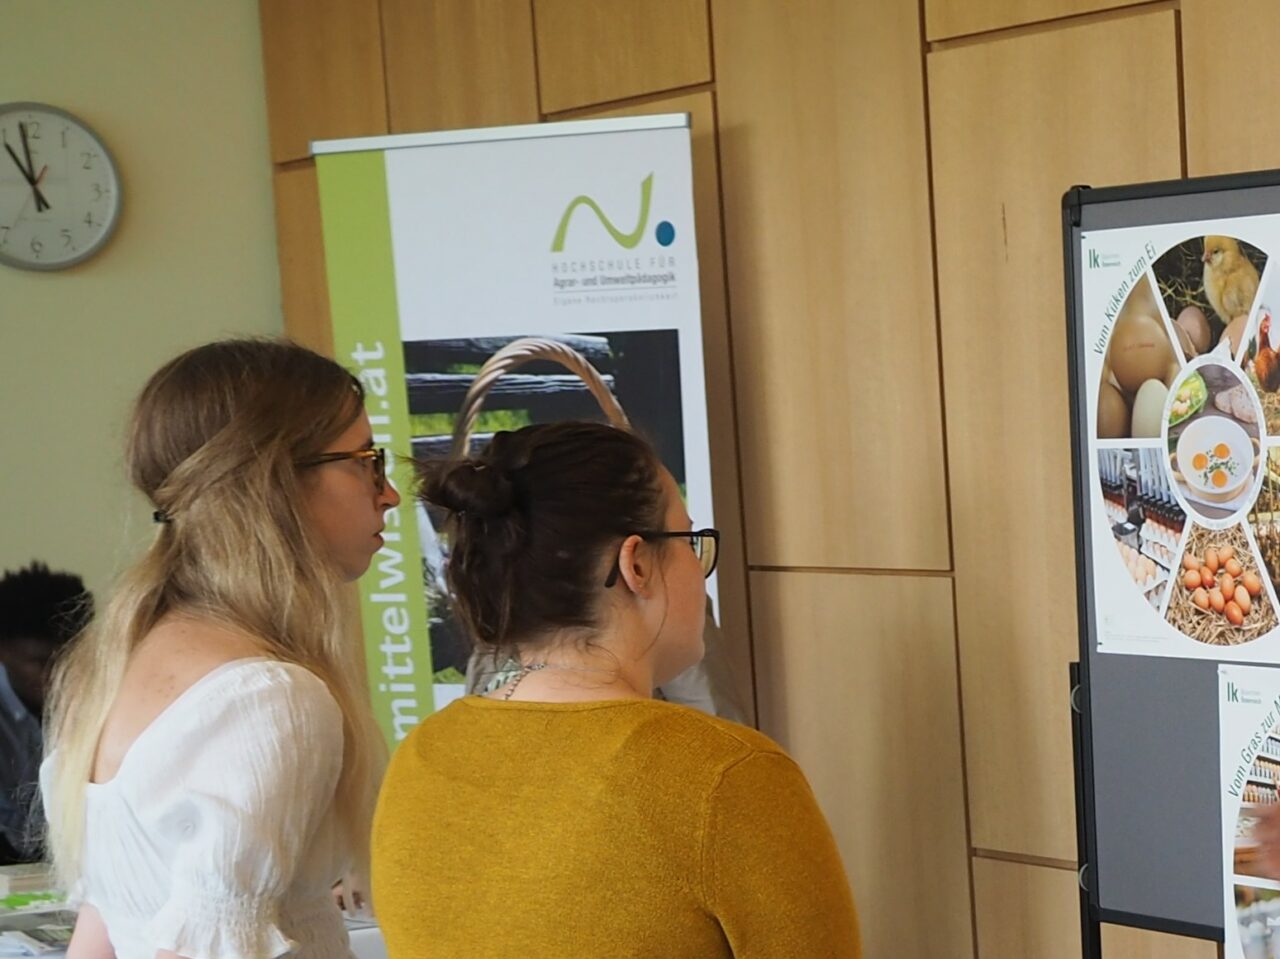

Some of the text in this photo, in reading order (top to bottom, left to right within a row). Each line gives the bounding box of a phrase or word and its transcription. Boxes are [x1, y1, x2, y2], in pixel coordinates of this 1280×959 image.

[82, 152, 92, 170] 2
[91, 183, 103, 202] 3
[84, 212, 94, 228] 4
[30, 236, 43, 254] 6
[61, 229, 72, 247] 5
[552, 259, 641, 273] HOCHSCHULE
[582, 277, 597, 286] und
[1093, 323, 1109, 355] Vom
[1106, 280, 1129, 322] Küken
[1128, 256, 1148, 282] zum
[1144, 239, 1158, 261] Ei
[1228, 762, 1247, 799] Vom
[1240, 732, 1262, 765] Gras
[1260, 710, 1276, 734] zur
